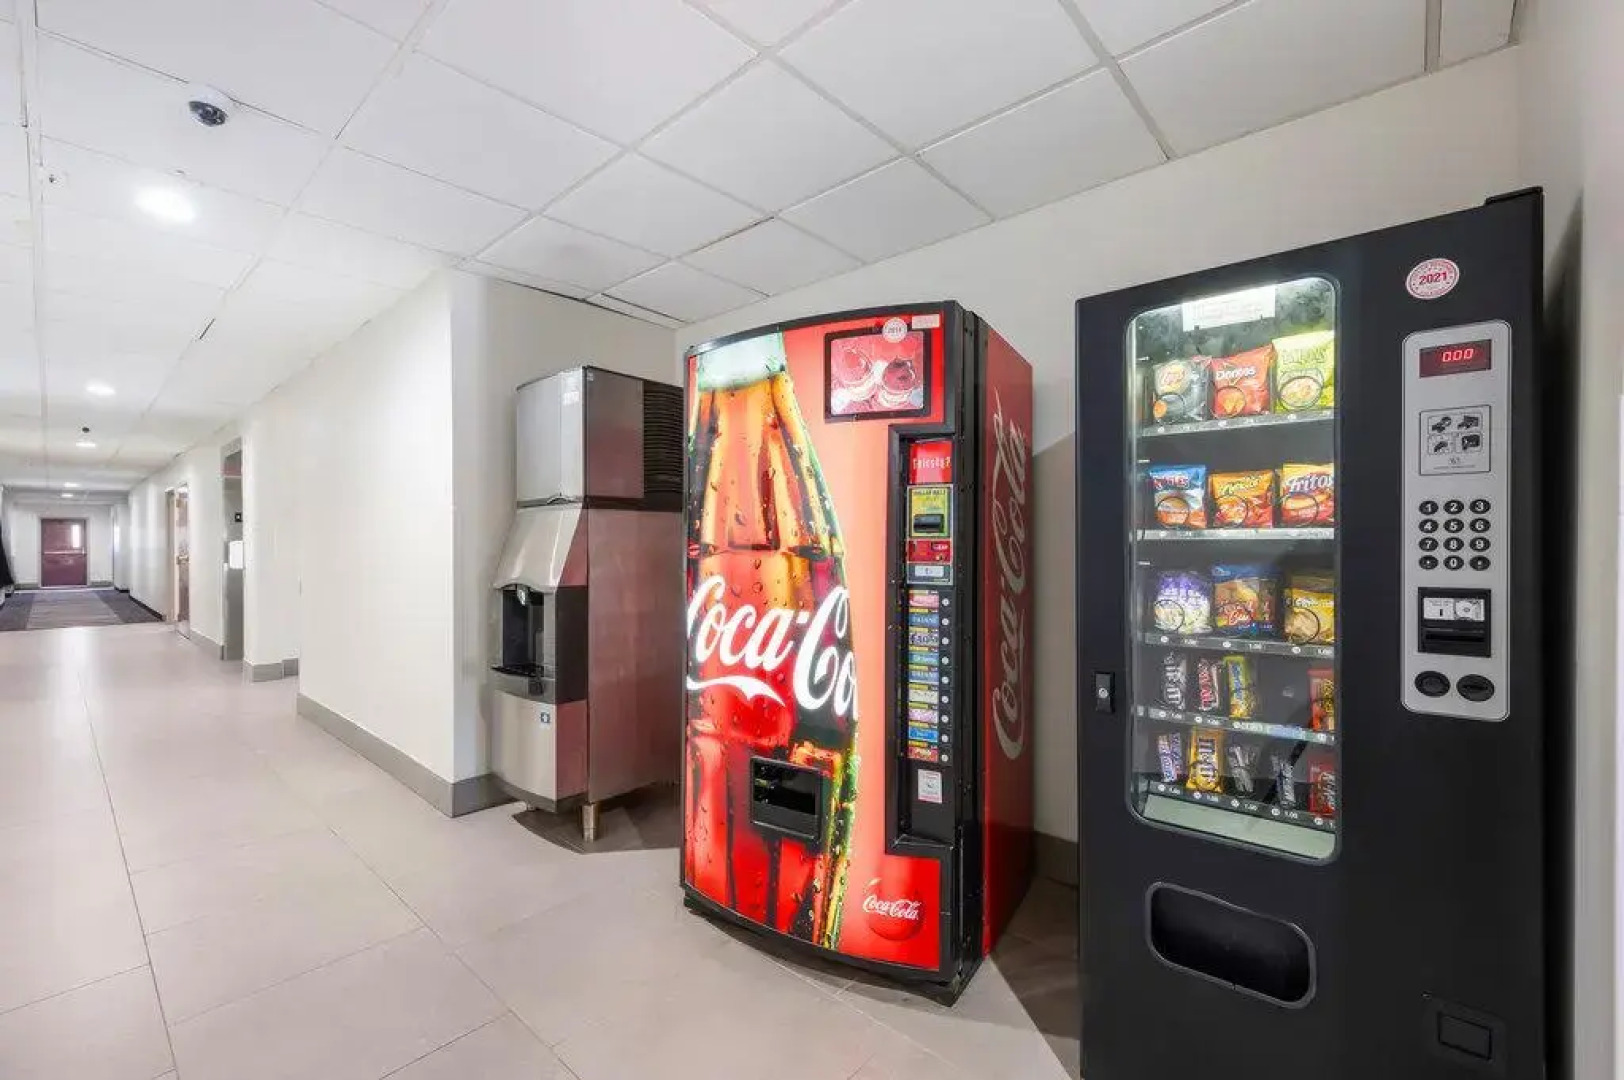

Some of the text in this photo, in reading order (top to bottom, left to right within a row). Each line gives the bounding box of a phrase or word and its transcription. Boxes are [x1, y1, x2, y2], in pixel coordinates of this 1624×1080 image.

[1419, 271, 1448, 285] 2021
[1216, 366, 1257, 380] Doritos
[1425, 501, 1484, 512] 1 2 3
[1423, 521, 1484, 531] 4 5 6
[1425, 540, 1484, 550] 7 8 9
[1449, 558, 1458, 567] 0
[687, 574, 858, 720] Coca-Co
[862, 894, 922, 920] Coca-Cola
